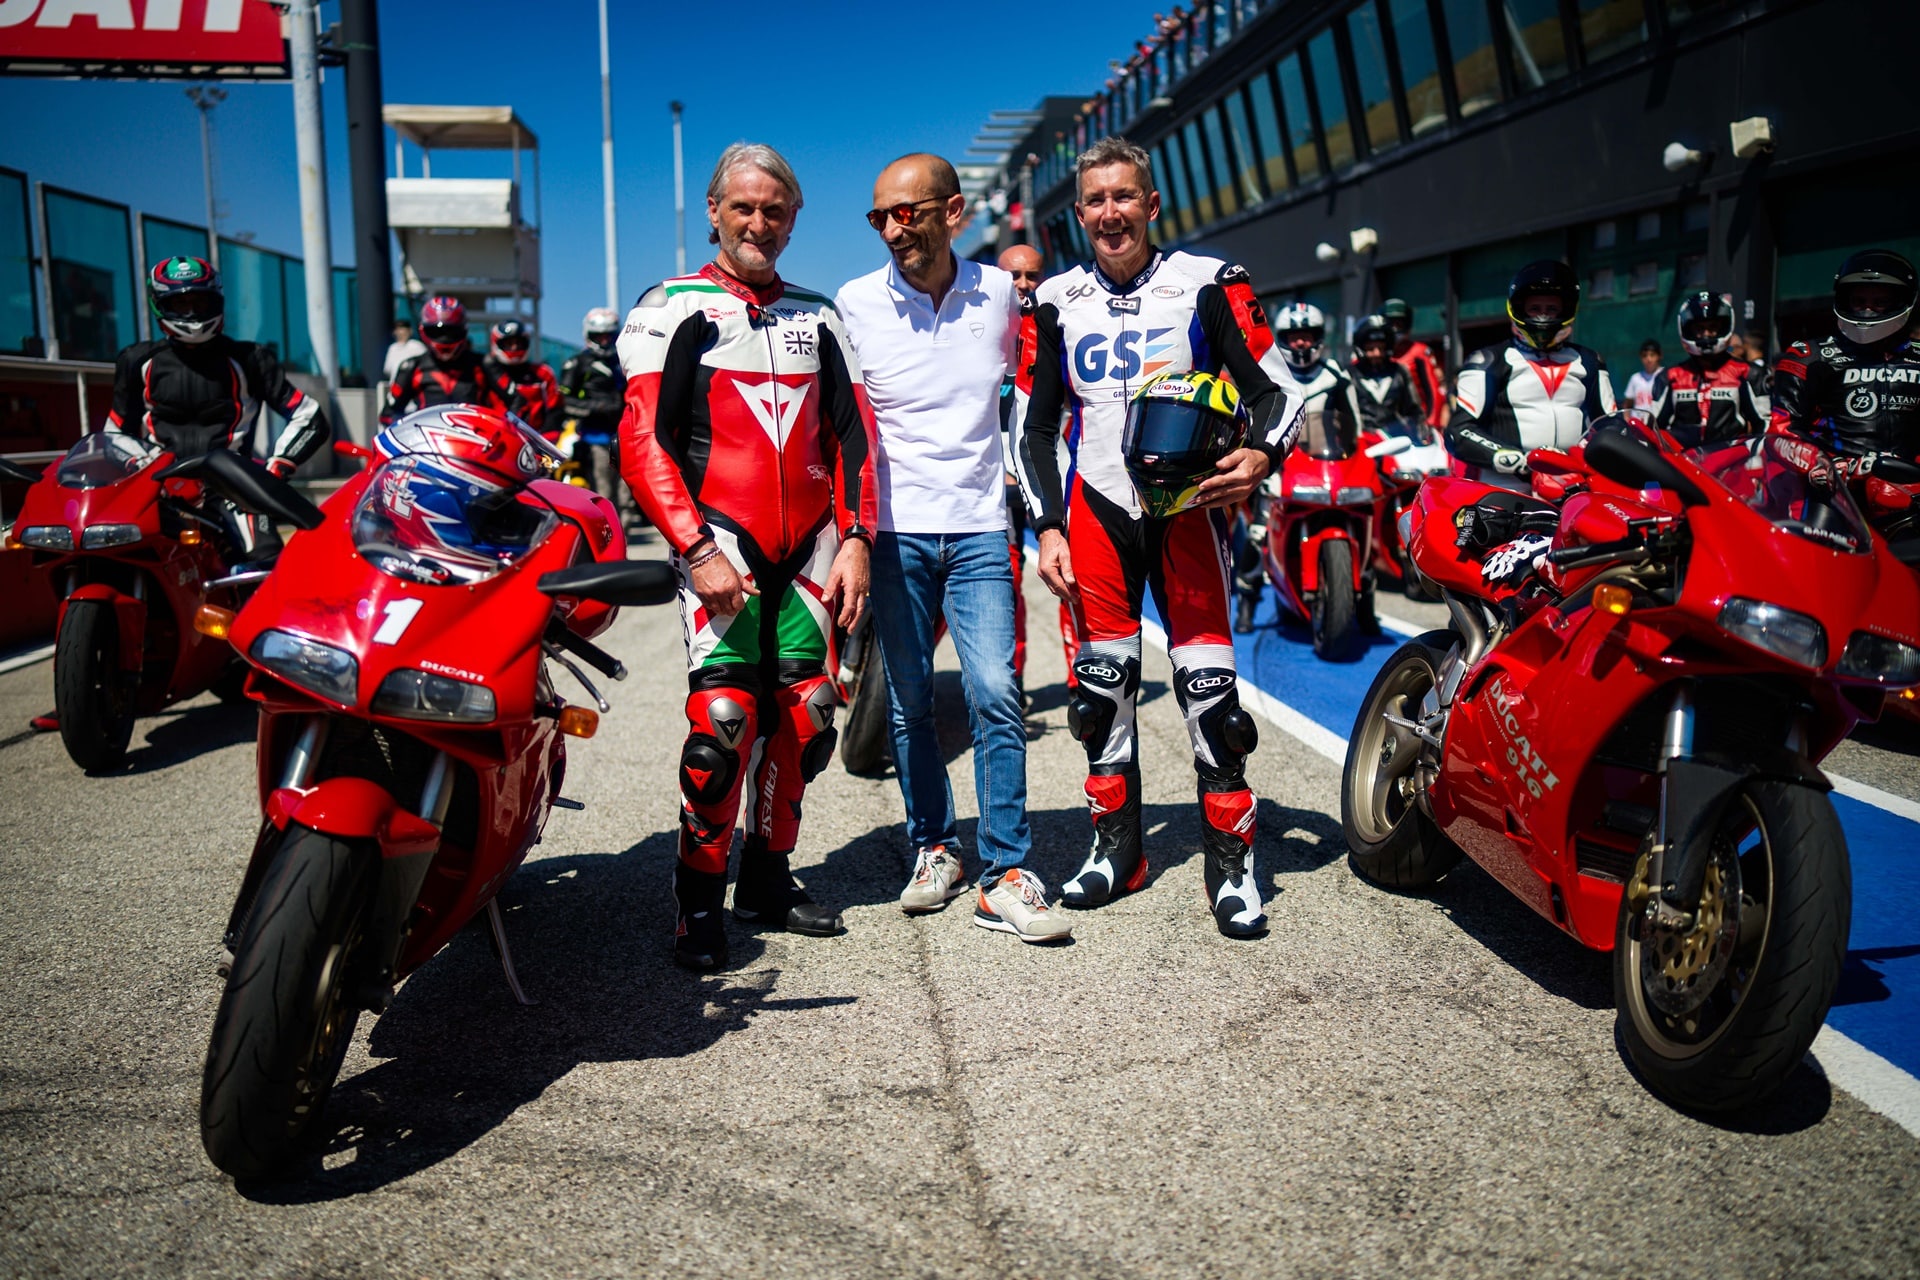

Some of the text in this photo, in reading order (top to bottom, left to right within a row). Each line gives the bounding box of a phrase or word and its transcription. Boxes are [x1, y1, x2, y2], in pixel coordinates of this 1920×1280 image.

[1149, 383, 1191, 394] SUOMY
[1843, 367, 1920, 384] DUCAT
[1603, 502, 1632, 523] DUCA
[372, 597, 424, 646] 1
[420, 660, 484, 682] DUCATI
[1490, 679, 1560, 792] DUCATI
[1506, 746, 1543, 799] 916
[761, 761, 778, 840] DAINESE
